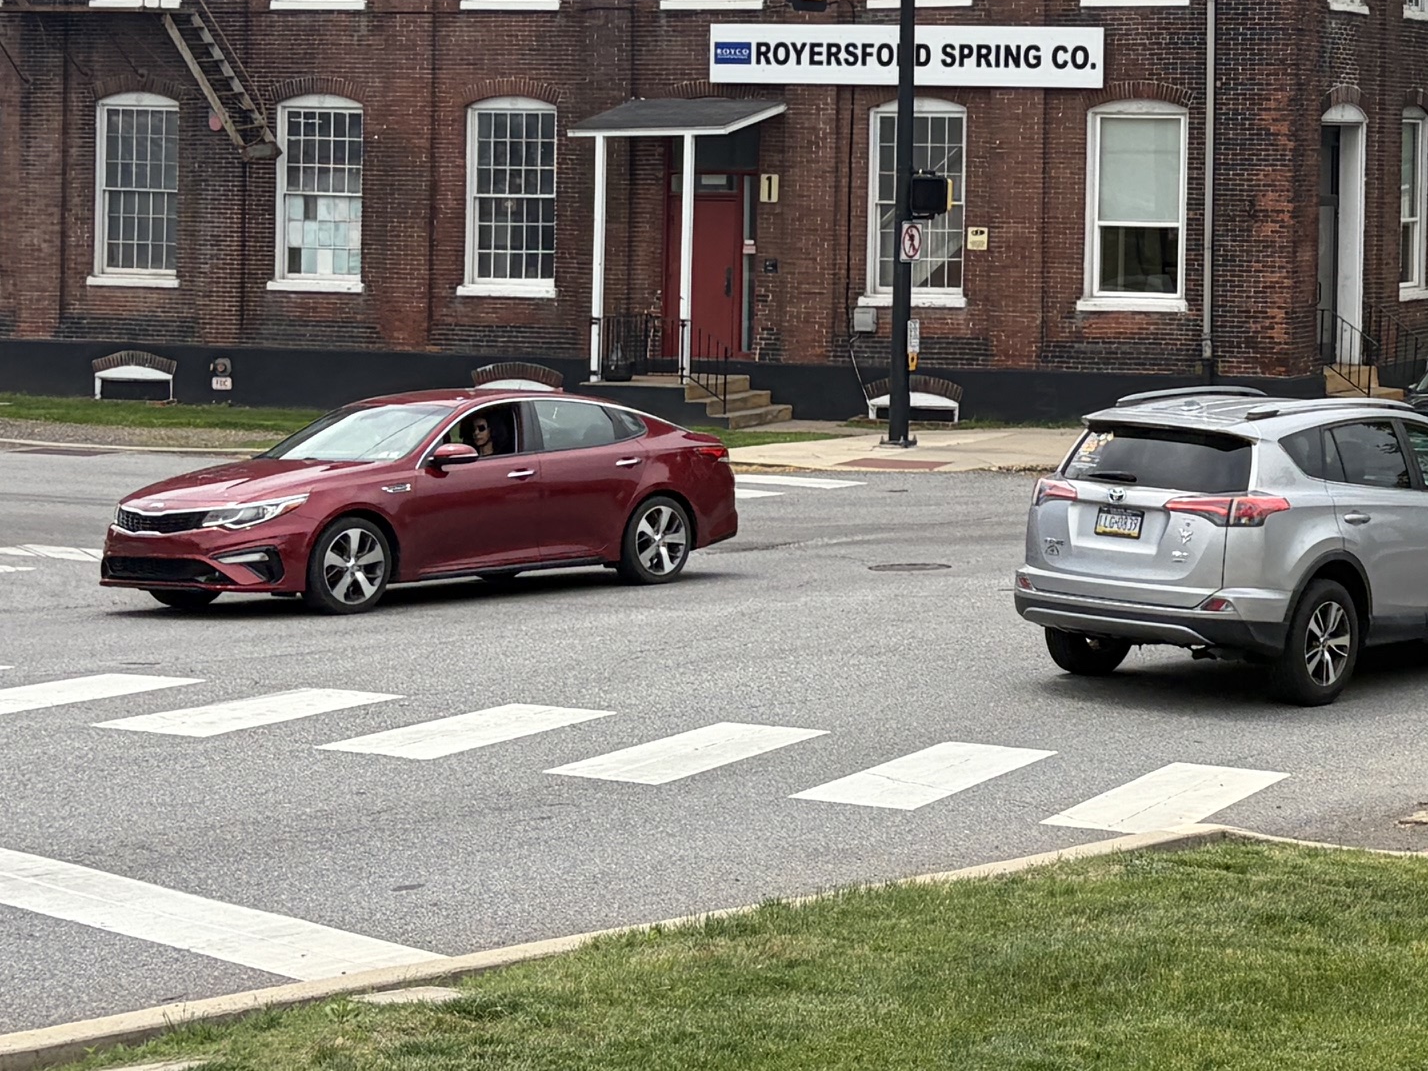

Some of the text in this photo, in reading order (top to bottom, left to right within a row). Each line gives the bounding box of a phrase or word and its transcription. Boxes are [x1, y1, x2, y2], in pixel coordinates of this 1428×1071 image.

[716, 48, 749, 56] ROYCO
[755, 41, 1097, 70] ROYERSFOD SPRING CO.
[765, 175, 772, 201] 1
